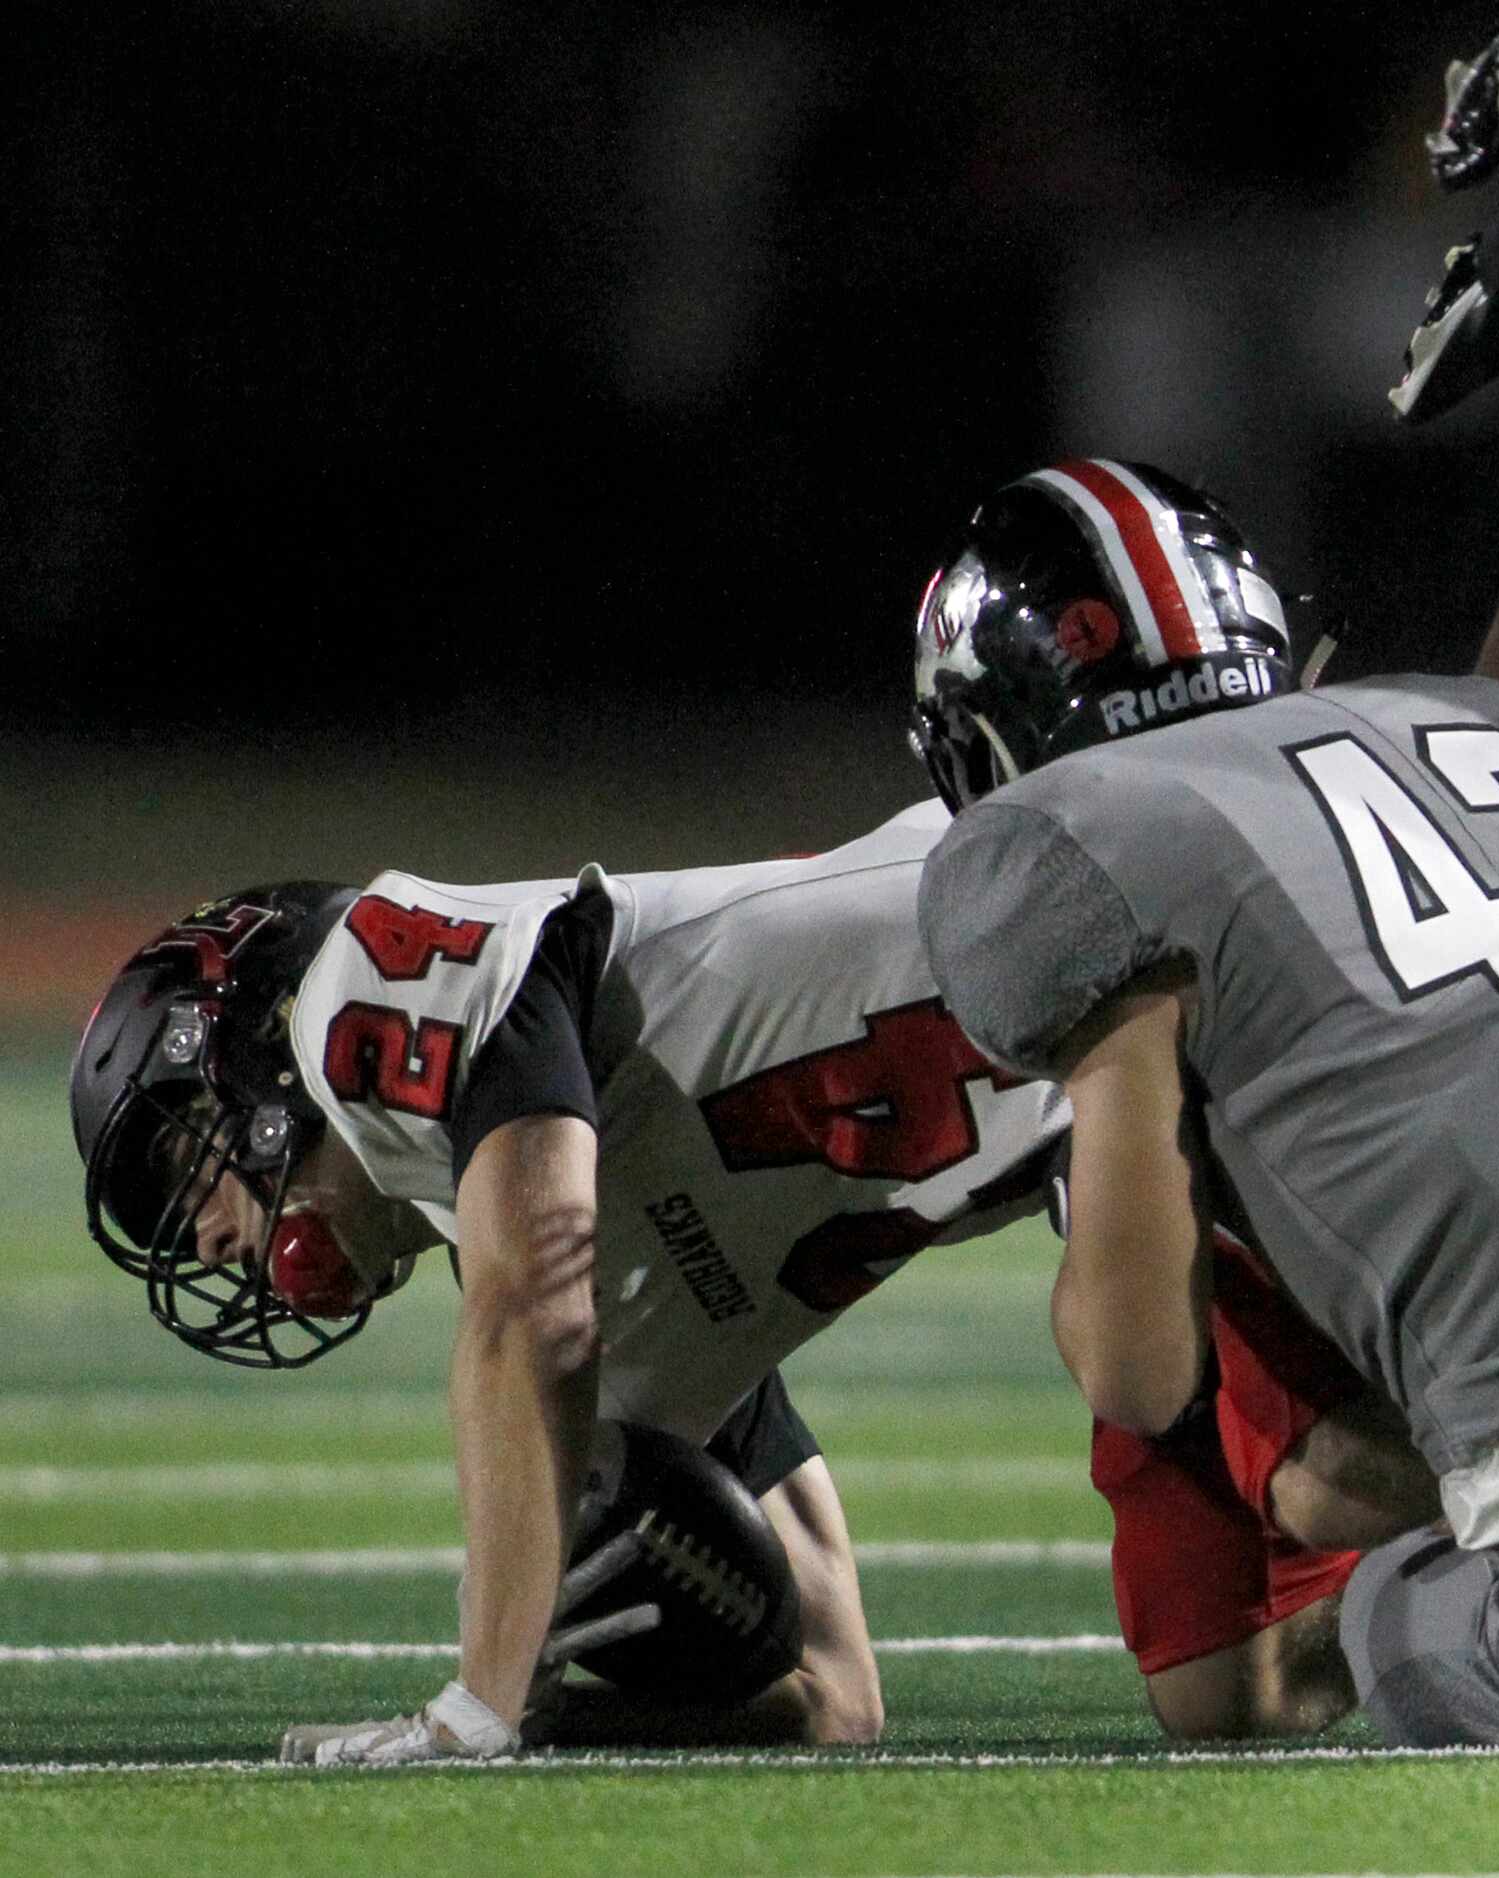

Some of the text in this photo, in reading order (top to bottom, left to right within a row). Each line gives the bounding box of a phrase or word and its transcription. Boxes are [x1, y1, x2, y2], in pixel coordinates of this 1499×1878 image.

[1100, 657, 1272, 735] Riddell
[326, 894, 497, 1123] 24
[645, 1192, 757, 1324] REDHAWKS
